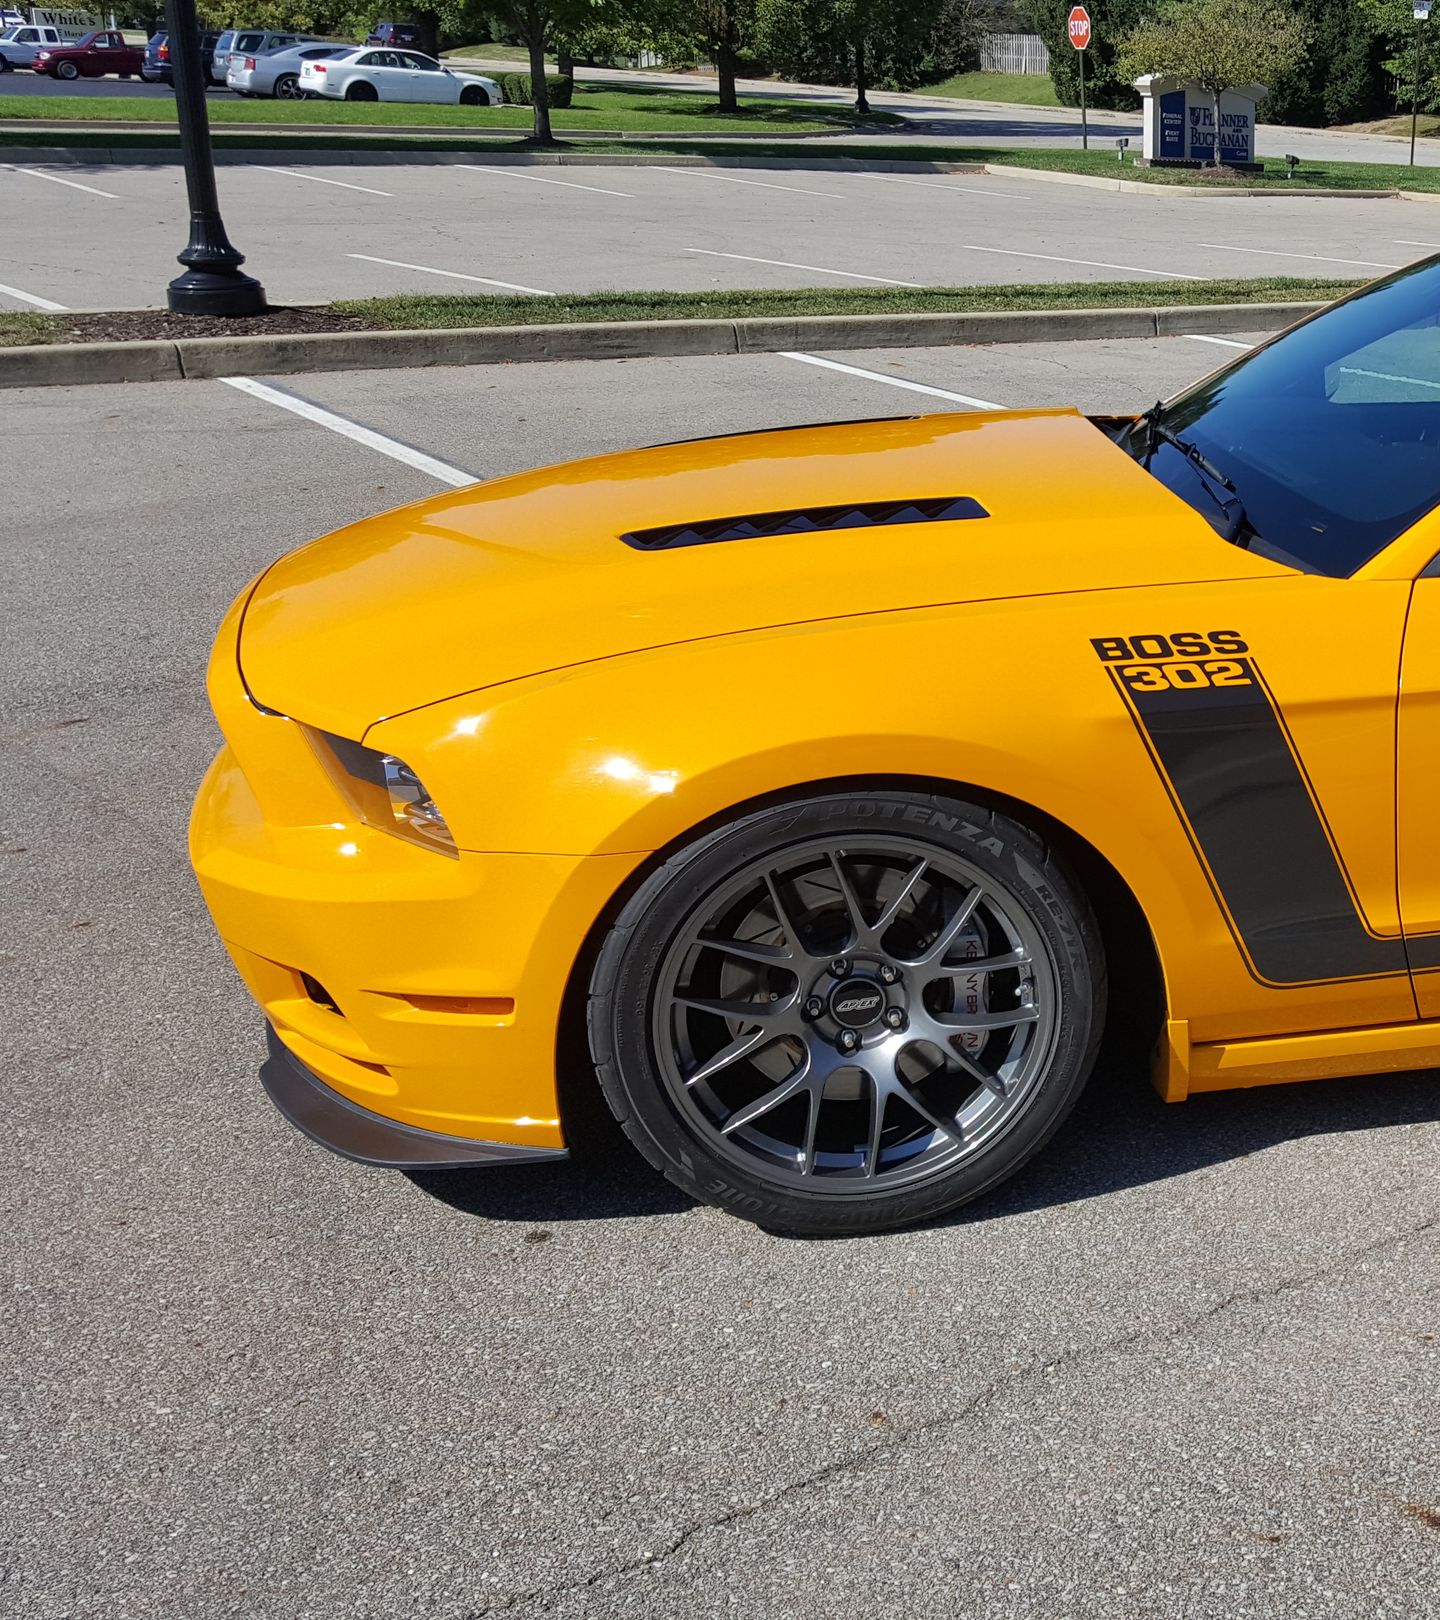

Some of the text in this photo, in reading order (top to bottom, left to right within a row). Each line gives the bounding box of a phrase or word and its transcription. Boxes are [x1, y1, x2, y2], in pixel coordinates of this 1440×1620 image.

[1070, 20, 1089, 36] STOP
[1202, 108, 1249, 128] FLNNER
[1089, 630, 1249, 662] BOSS
[1122, 661, 1252, 692] 302
[819, 799, 1005, 858] POTENZA
[966, 940, 978, 992] KENY
